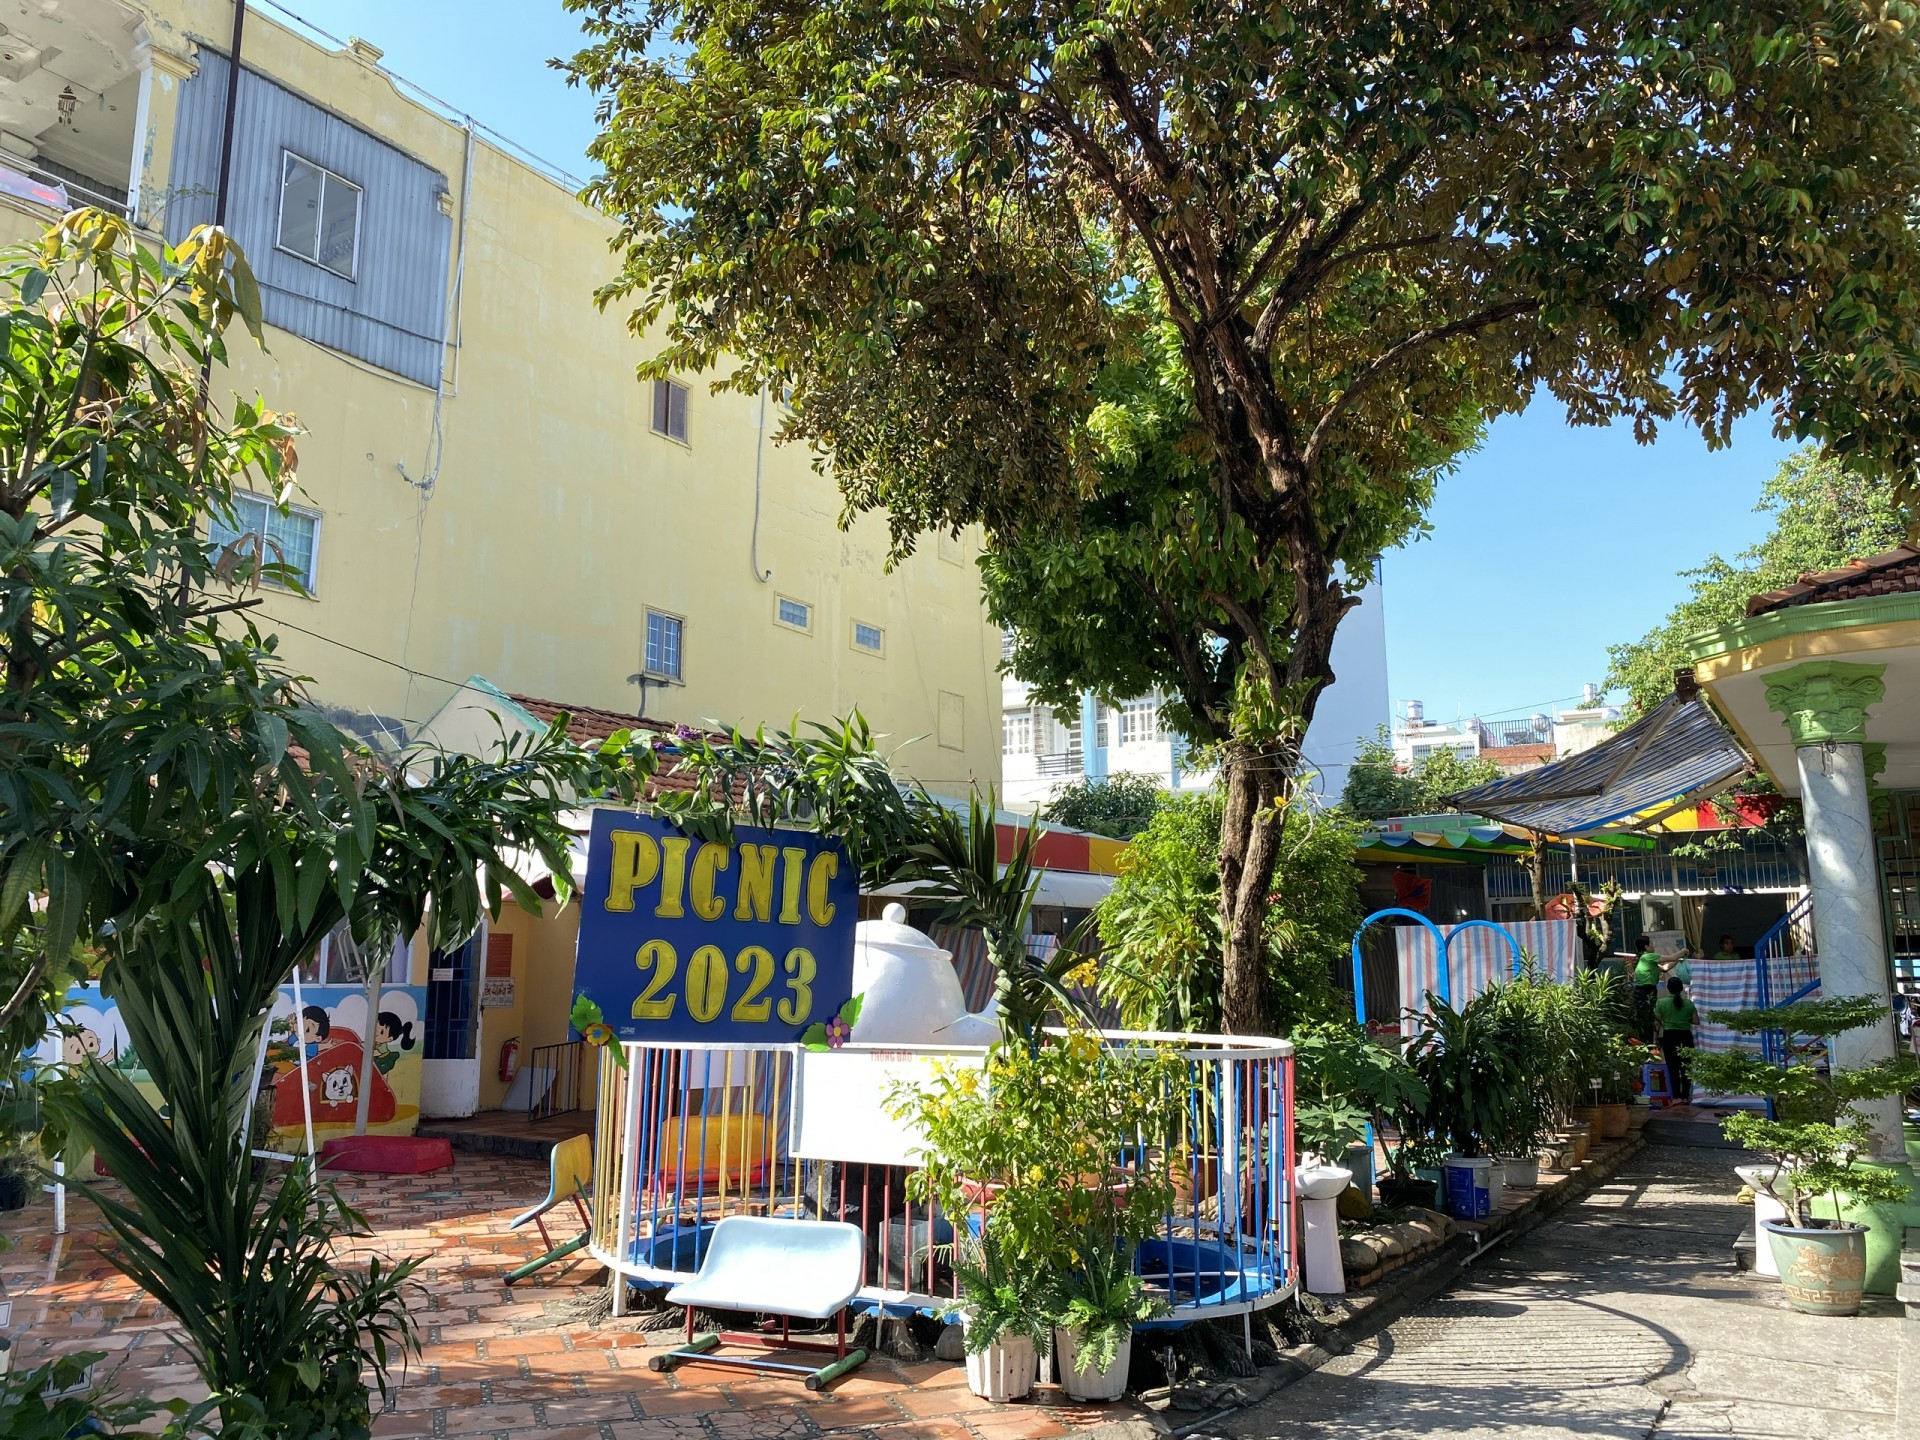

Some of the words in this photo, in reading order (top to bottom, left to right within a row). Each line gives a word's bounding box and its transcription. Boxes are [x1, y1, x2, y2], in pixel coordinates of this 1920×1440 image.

[605, 829, 838, 927] PICNIC
[631, 939, 816, 1025] 2023
[870, 1049, 895, 1062] THÔNG
